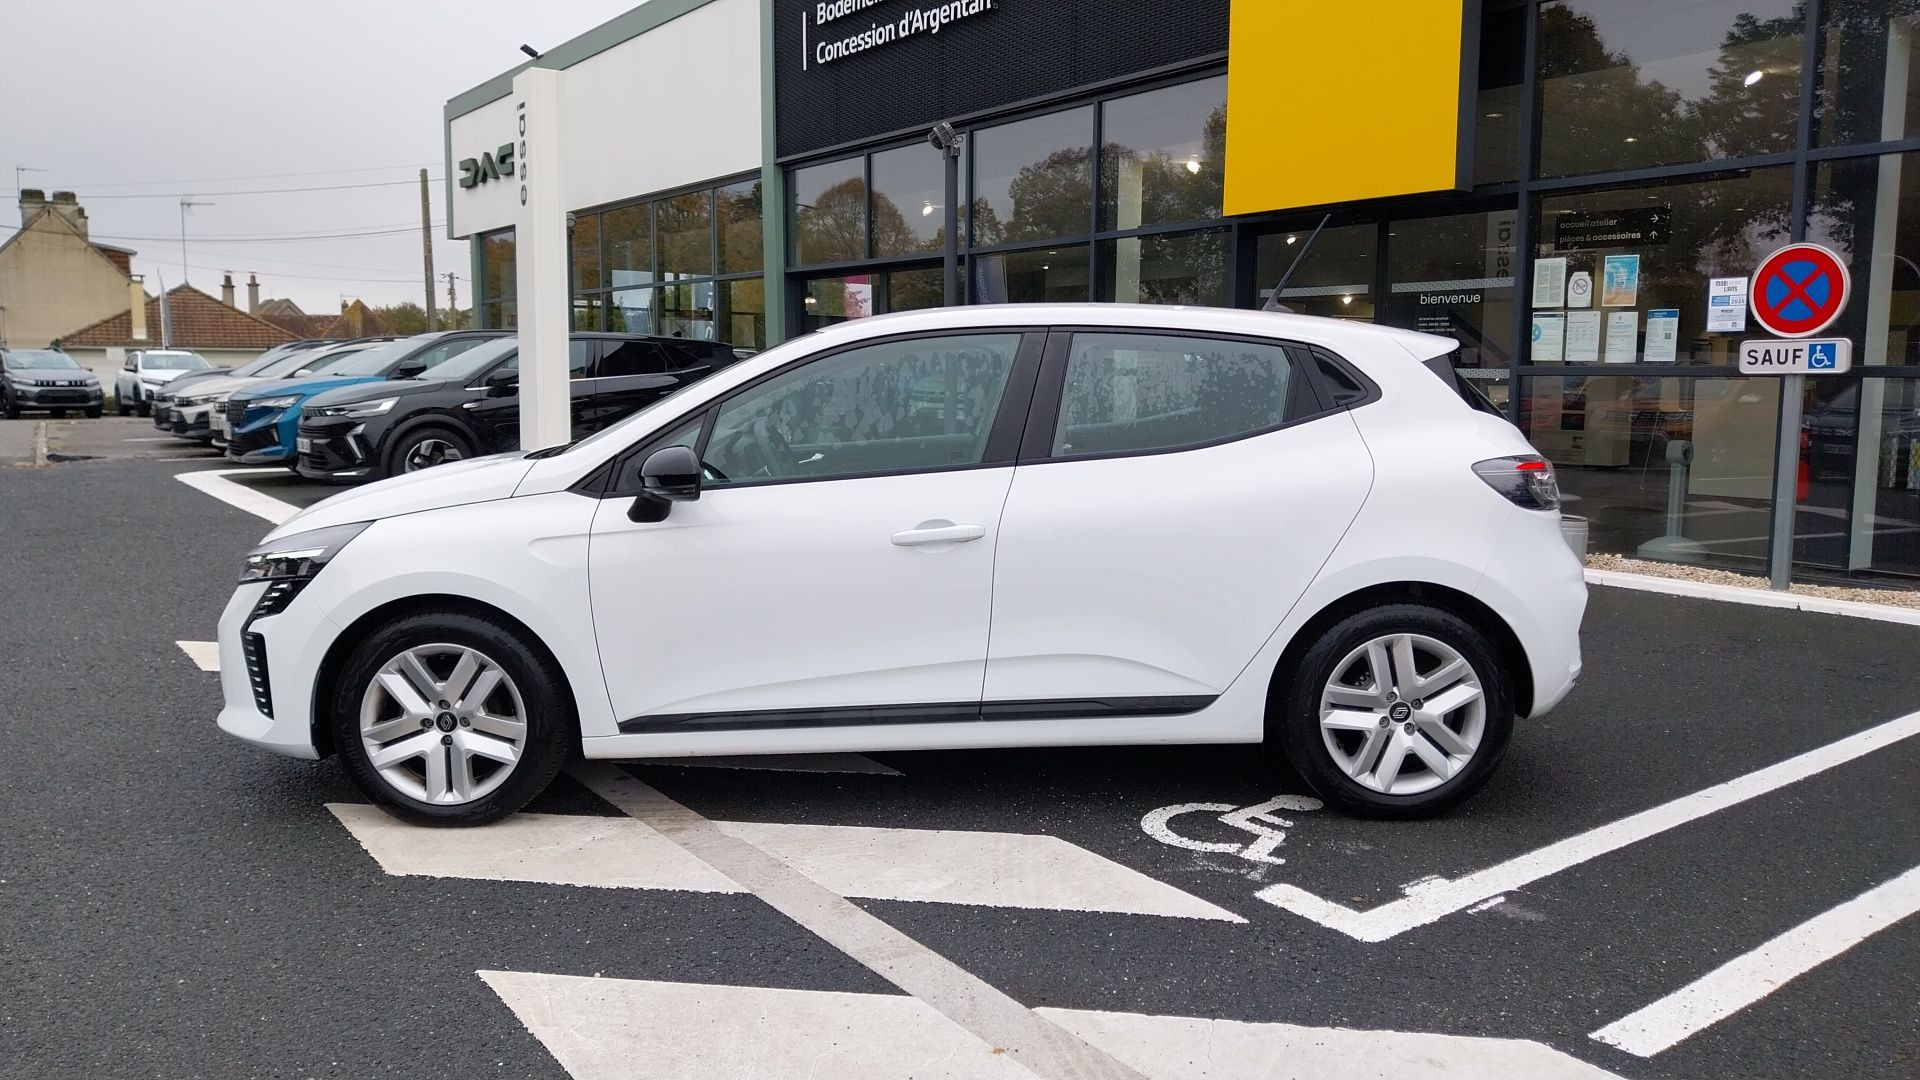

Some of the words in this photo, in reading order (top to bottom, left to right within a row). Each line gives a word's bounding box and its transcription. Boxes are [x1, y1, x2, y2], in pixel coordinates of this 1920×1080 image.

[816, 22, 896, 64] Concession
[516, 101, 528, 207] essai
[1592, 231, 1642, 241] accessoires
[1420, 293, 1481, 305] bienvenue
[1746, 348, 1804, 366] SAUF
